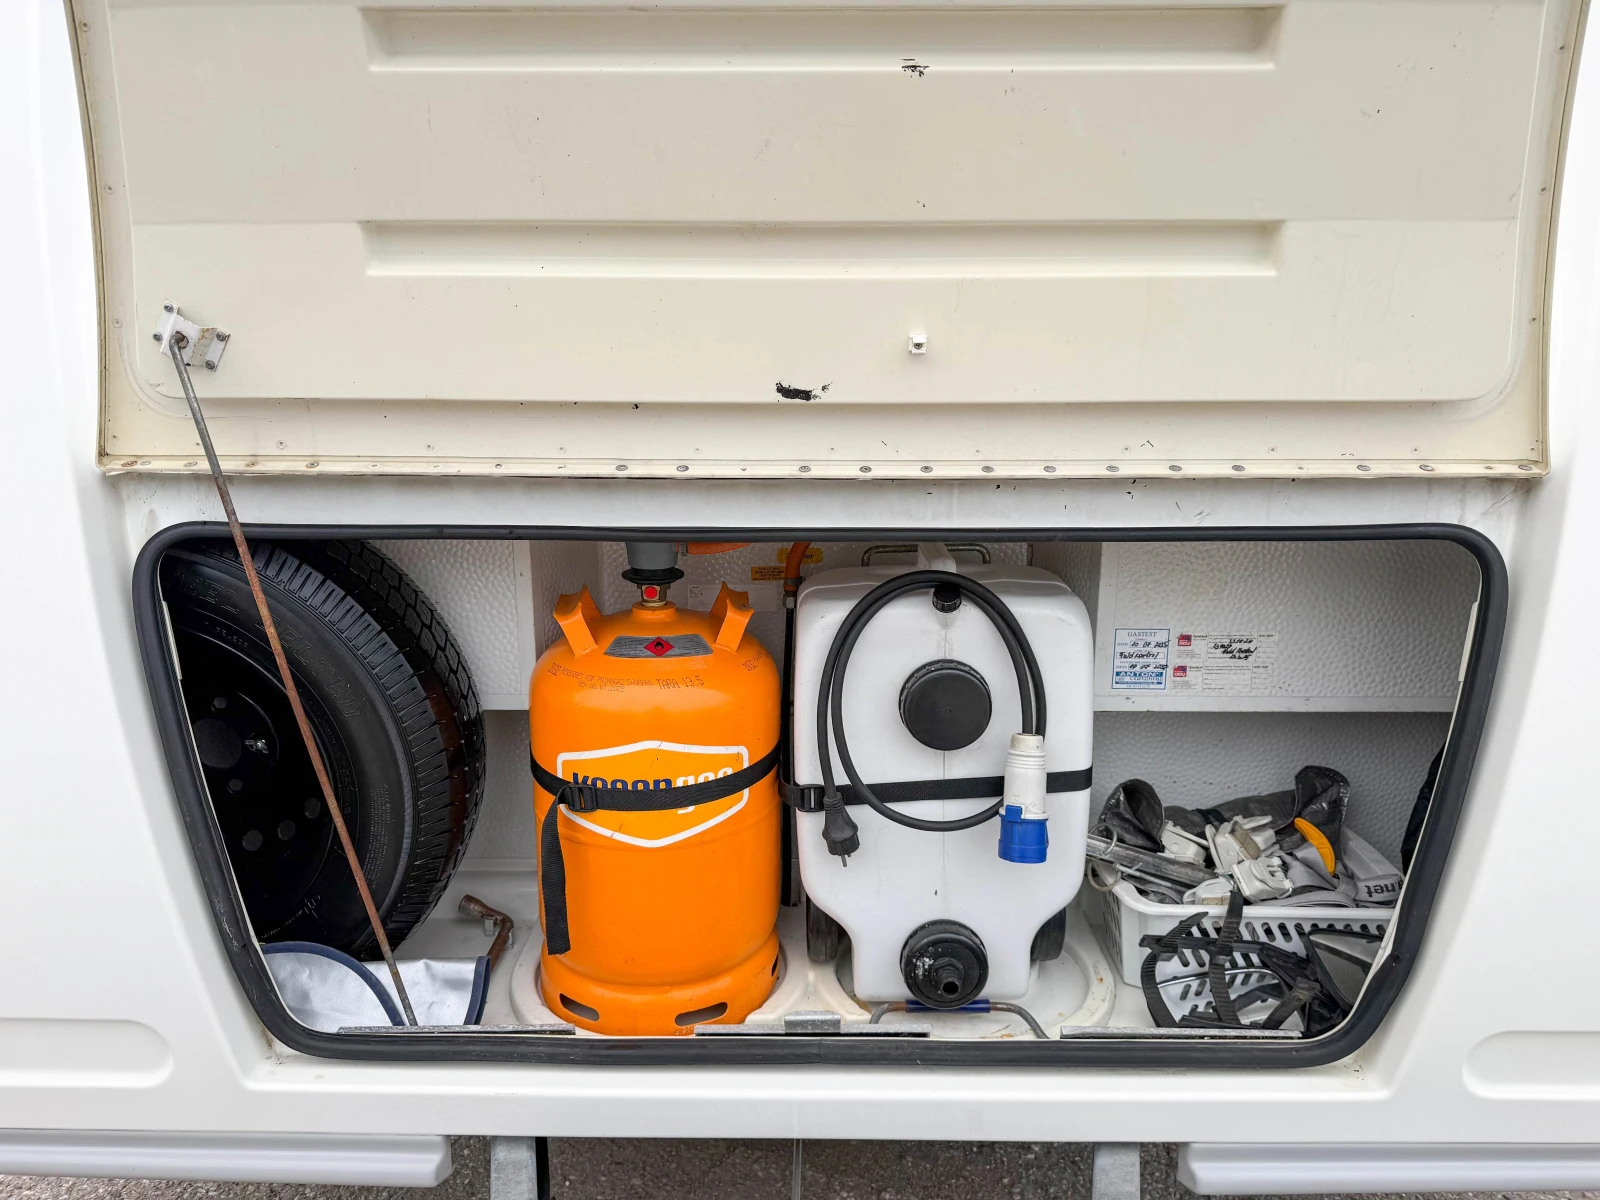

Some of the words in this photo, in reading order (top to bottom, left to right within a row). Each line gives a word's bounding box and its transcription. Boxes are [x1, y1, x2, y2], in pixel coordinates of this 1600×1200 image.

[585, 674, 596, 683] FOR
[597, 675, 625, 687] PRIMAGAZ
[656, 678, 681, 690] TARA
[683, 675, 705, 689] 13.5
